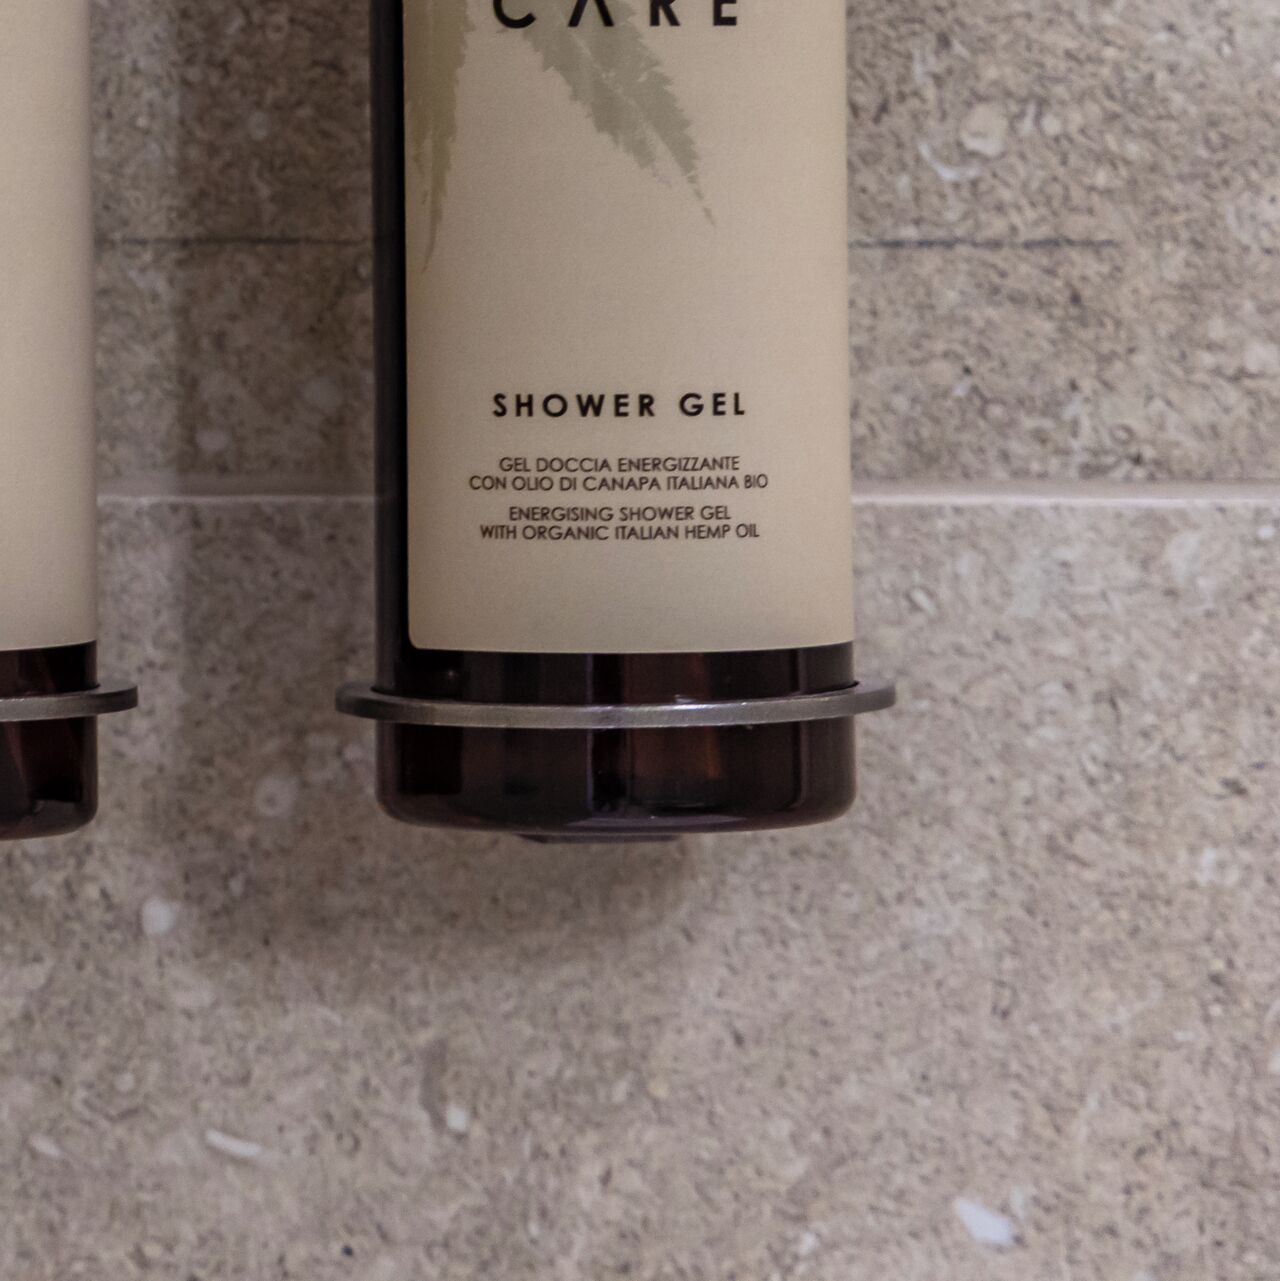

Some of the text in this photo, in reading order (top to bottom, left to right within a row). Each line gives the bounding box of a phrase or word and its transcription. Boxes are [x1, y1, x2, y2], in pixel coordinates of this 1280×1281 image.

[492, 392, 745, 417] SHOWER GEL
[499, 456, 740, 473] GEL DOCCIA ENERGIZZANTE
[469, 473, 768, 492] CON OLIO DI CANAPA ITALIANA BIO
[509, 506, 731, 522] ENERGISING SHOWER GEL
[480, 523, 760, 541] WITH ORGANIC ITALIAN HEMP OIL
